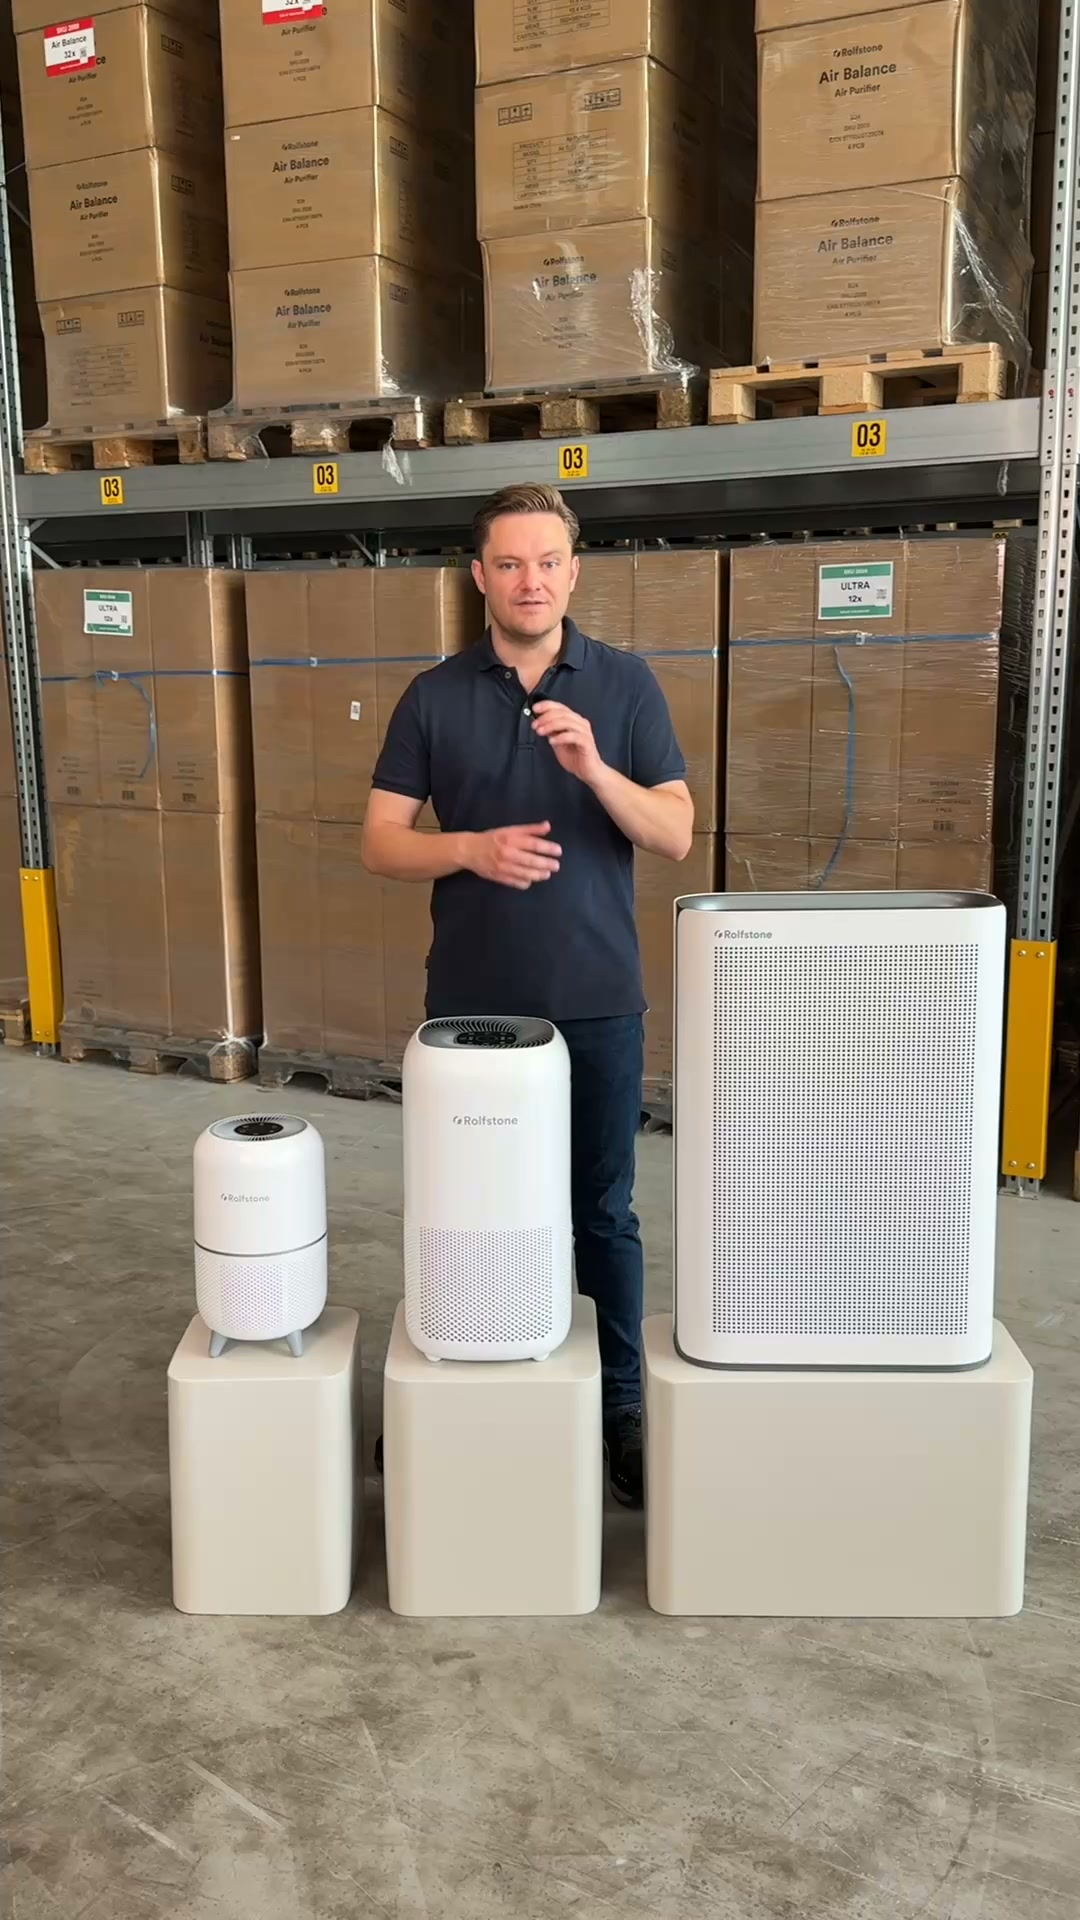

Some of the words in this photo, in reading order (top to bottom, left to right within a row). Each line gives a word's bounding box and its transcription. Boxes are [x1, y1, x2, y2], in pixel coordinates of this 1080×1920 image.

[51, 40, 61, 49] Air
[61, 35, 87, 47] Balance
[841, 44, 883, 57] Rolfstone
[818, 69, 840, 84] Air
[843, 63, 897, 80] Balance
[834, 88, 848, 97] Air
[849, 84, 880, 95] Purifier
[272, 160, 288, 173] Air
[290, 157, 330, 171] Balance
[284, 176, 294, 184] Air
[294, 173, 319, 182] Purifier
[70, 199, 82, 211] Air
[84, 195, 118, 208] Balance
[839, 216, 880, 227] Rolfstone
[817, 239, 837, 253] Air
[841, 235, 894, 250] Balance
[832, 257, 845, 265] Air
[846, 254, 877, 264] Purifier
[552, 273, 597, 287] Balance
[275, 305, 290, 318] Air
[292, 303, 332, 316] Balance
[287, 321, 297, 329] Air
[297, 319, 320, 328] Purifier
[857, 423, 881, 447] 03
[563, 447, 583, 470] 03
[317, 465, 335, 486] 03
[103, 478, 120, 497] 03
[840, 581, 870, 591] ULTRA
[848, 595, 862, 603] 12x
[98, 604, 118, 612] ULTRA
[724, 929, 773, 939] Rolfstone
[464, 1115, 518, 1126] Rolfstone
[228, 1193, 270, 1203] Rolfstone
